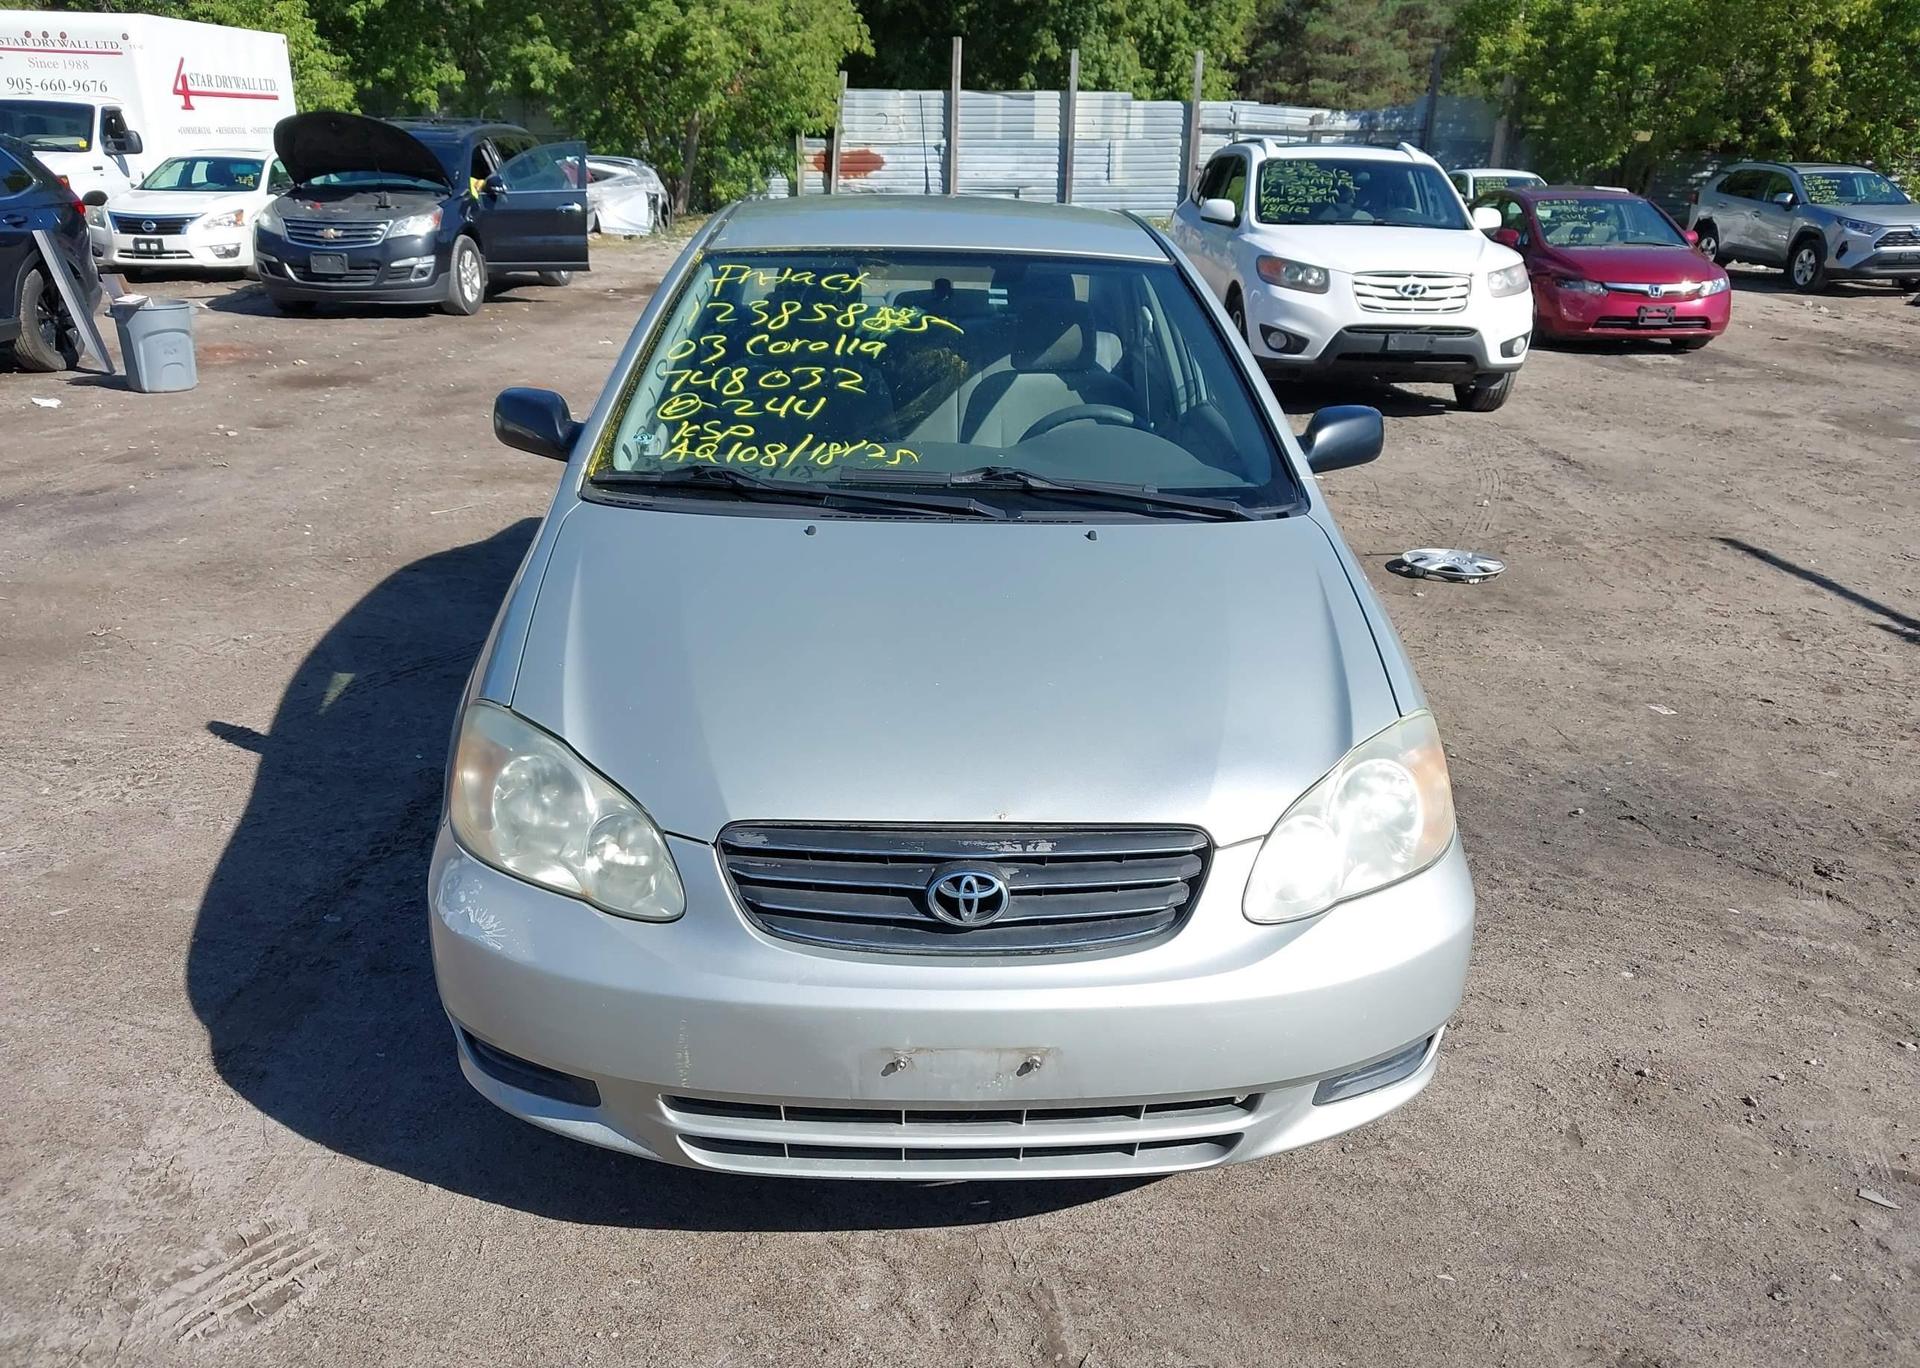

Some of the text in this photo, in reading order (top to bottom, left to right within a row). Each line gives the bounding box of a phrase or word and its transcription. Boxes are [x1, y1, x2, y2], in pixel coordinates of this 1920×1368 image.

[31, 38, 93, 49] DRYWALL
[95, 40, 123, 50] LTD.
[27, 56, 90, 70] Since 1988
[6, 76, 108, 93] 905-660-9676
[172, 56, 196, 110] 4
[189, 72, 215, 88] STAR
[215, 74, 259, 91] DRYWALL
[667, 333, 889, 364] 03 Corolla
